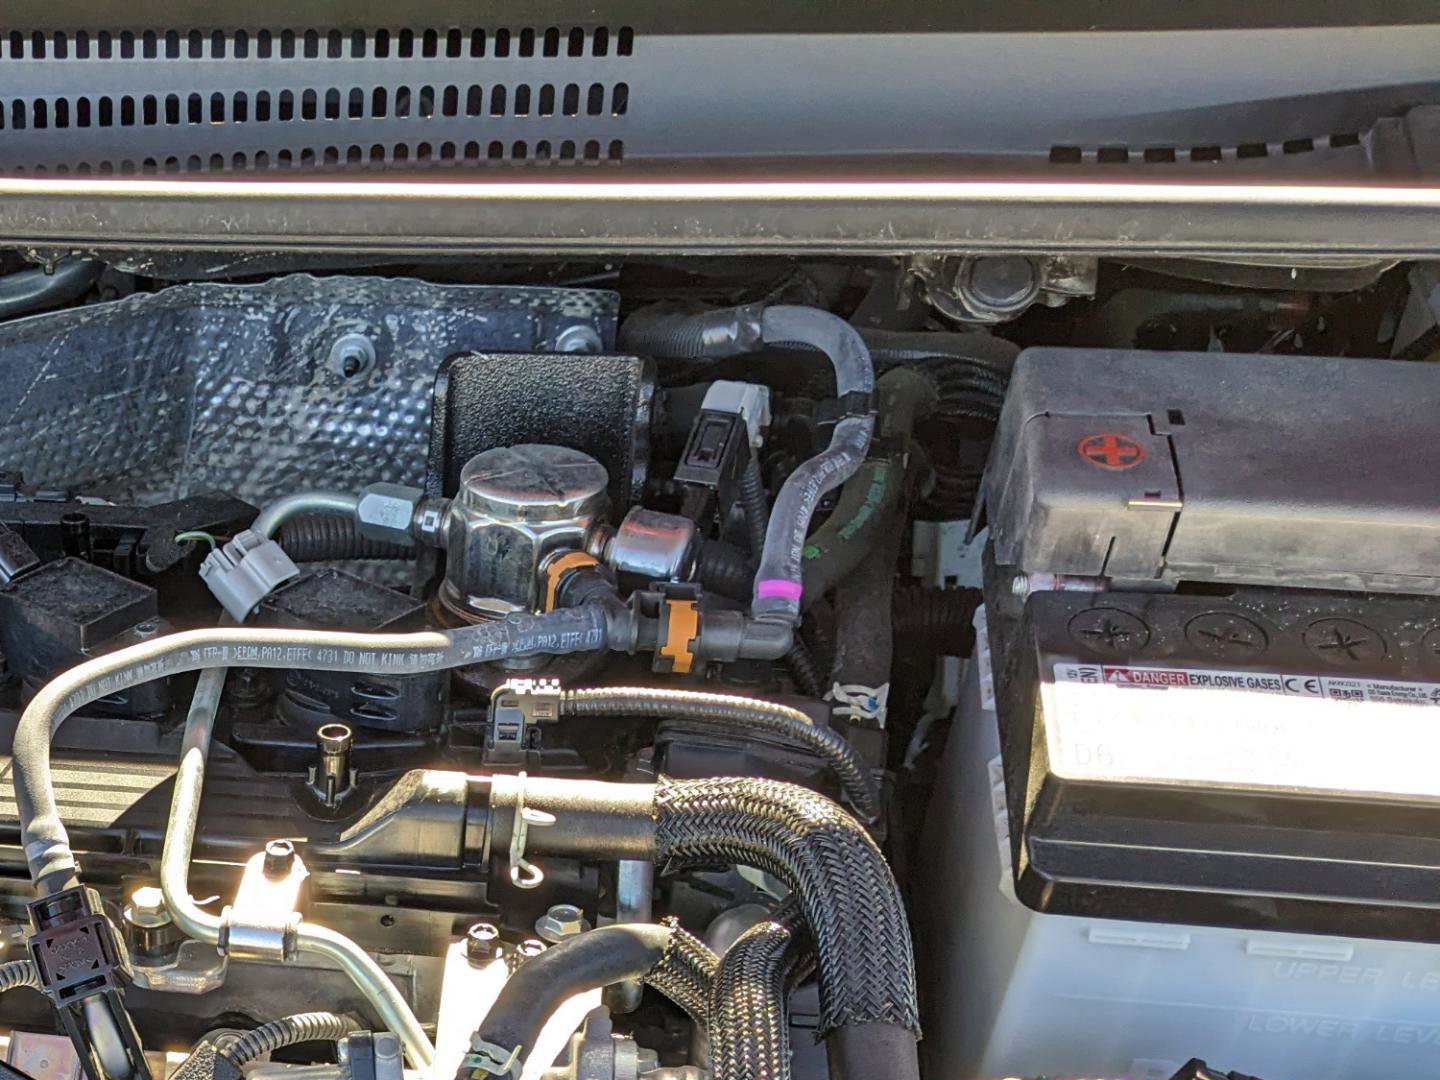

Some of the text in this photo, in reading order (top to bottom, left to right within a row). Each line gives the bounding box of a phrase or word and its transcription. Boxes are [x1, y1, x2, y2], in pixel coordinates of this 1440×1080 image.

[343, 650, 355, 664] DO
[360, 651, 377, 666] NOT
[381, 652, 405, 667] KINK
[1132, 671, 1186, 685] DANGER
[1190, 674, 1245, 688] EXPLOSIVE
[1247, 677, 1281, 691] GASES
[1272, 960, 1384, 986] UPPER
[1247, 1013, 1359, 1041] LOWER
